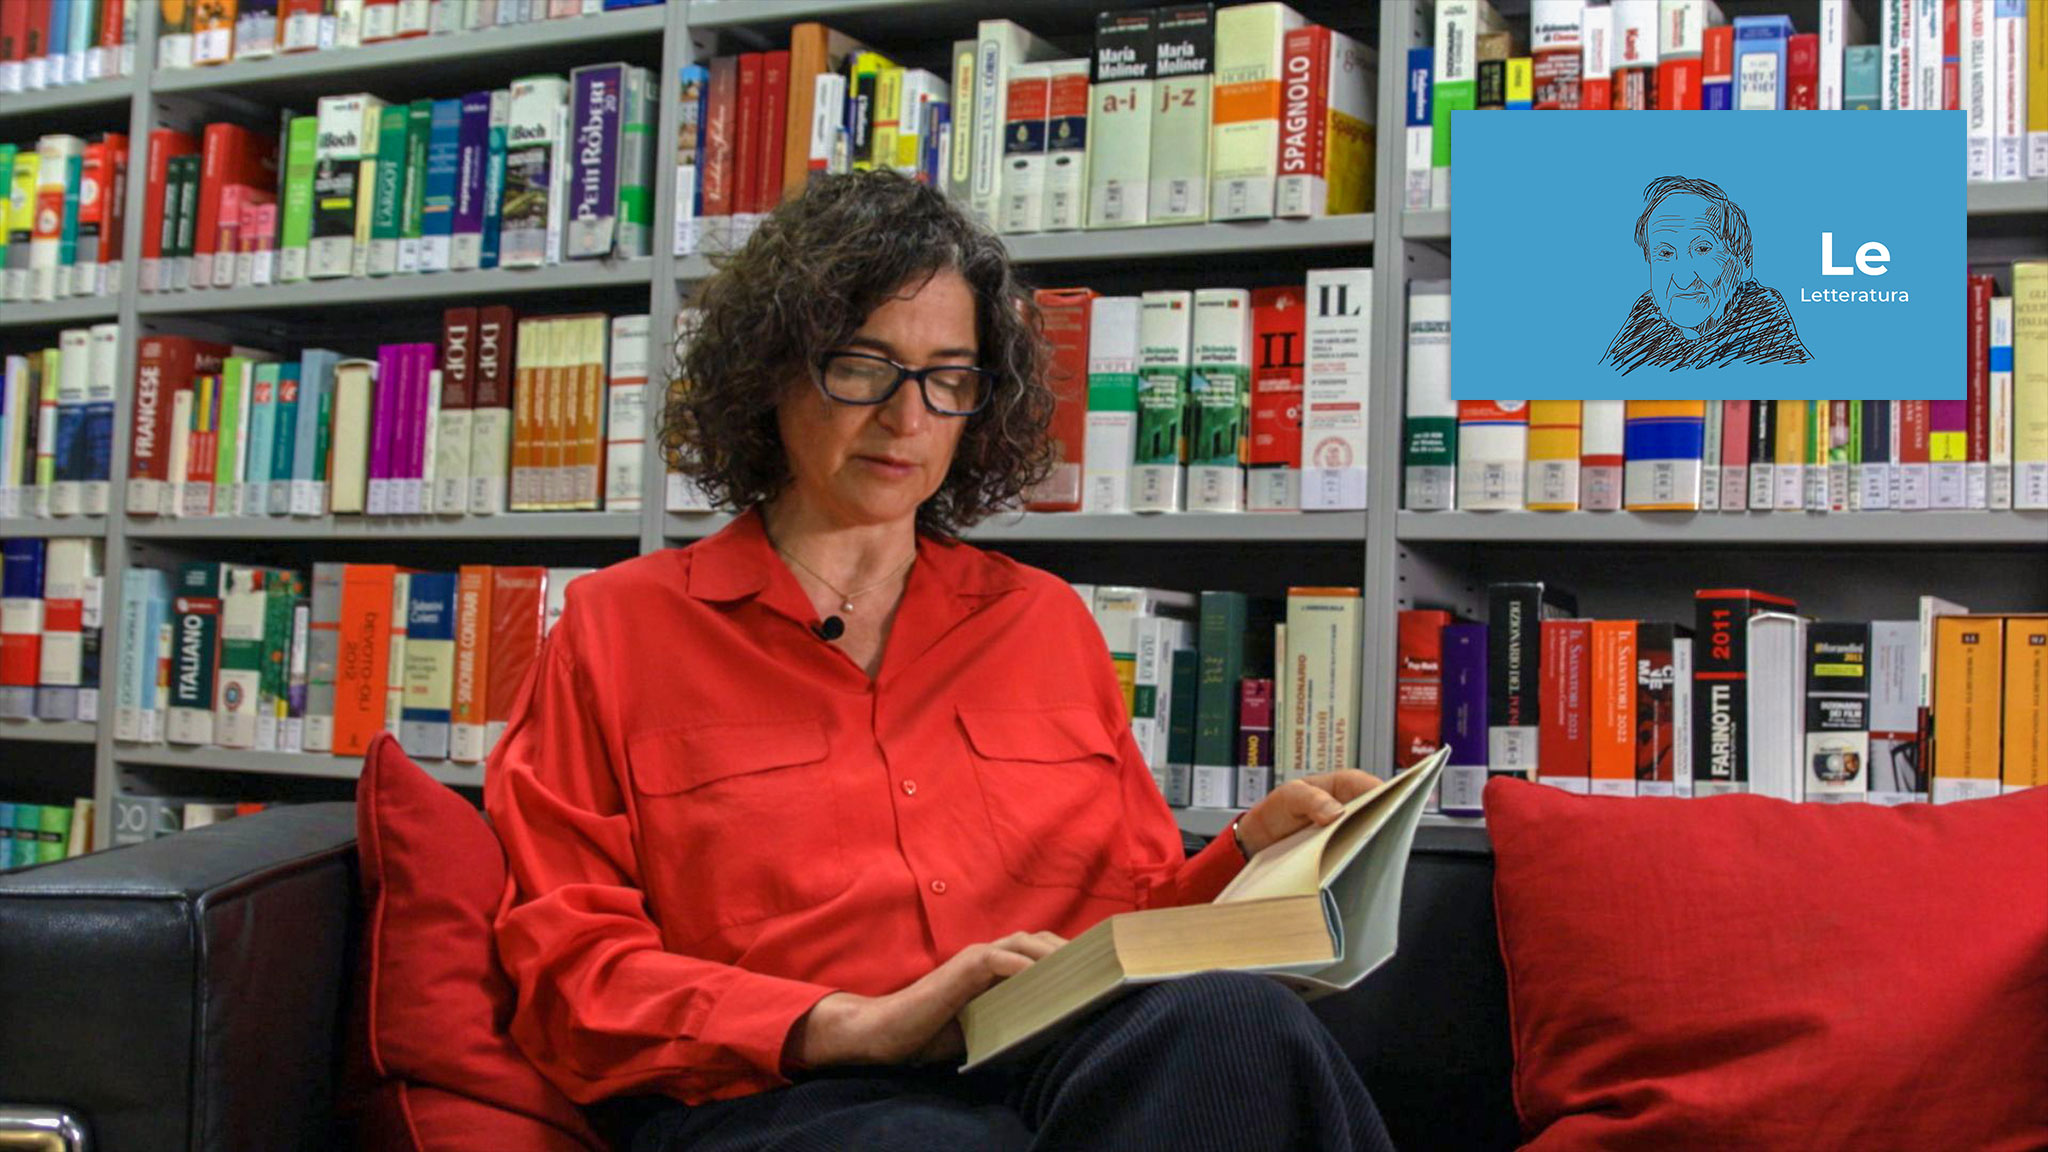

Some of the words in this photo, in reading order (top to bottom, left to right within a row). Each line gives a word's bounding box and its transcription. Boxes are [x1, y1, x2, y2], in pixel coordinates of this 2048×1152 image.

[1098, 62, 1148, 80] Moliner
[1099, 45, 1136, 63] María
[1157, 41, 1195, 60] María
[1157, 58, 1208, 76] Moliner
[1103, 87, 1136, 113] a-i
[1283, 55, 1310, 172] SPAGNOLO
[1319, 284, 1362, 317] IL
[446, 325, 468, 381] DOP
[479, 322, 500, 379] DOP
[1259, 331, 1304, 369] IL
[135, 365, 161, 458] FRANCESE
[179, 614, 204, 699] ITALIANO
[1508, 601, 1521, 668] DIZIONARIO
[1712, 608, 1731, 661] 2011
[1296, 654, 1307, 725] DIZIONARIO
[1508, 669, 1520, 695] DEL
[1294, 728, 1304, 770] RANDE
[1316, 710, 1328, 772] ОЛЬШОЙ
[1335, 717, 1347, 770] ОВАРЬ
[1710, 684, 1731, 777] FARINOTTI
